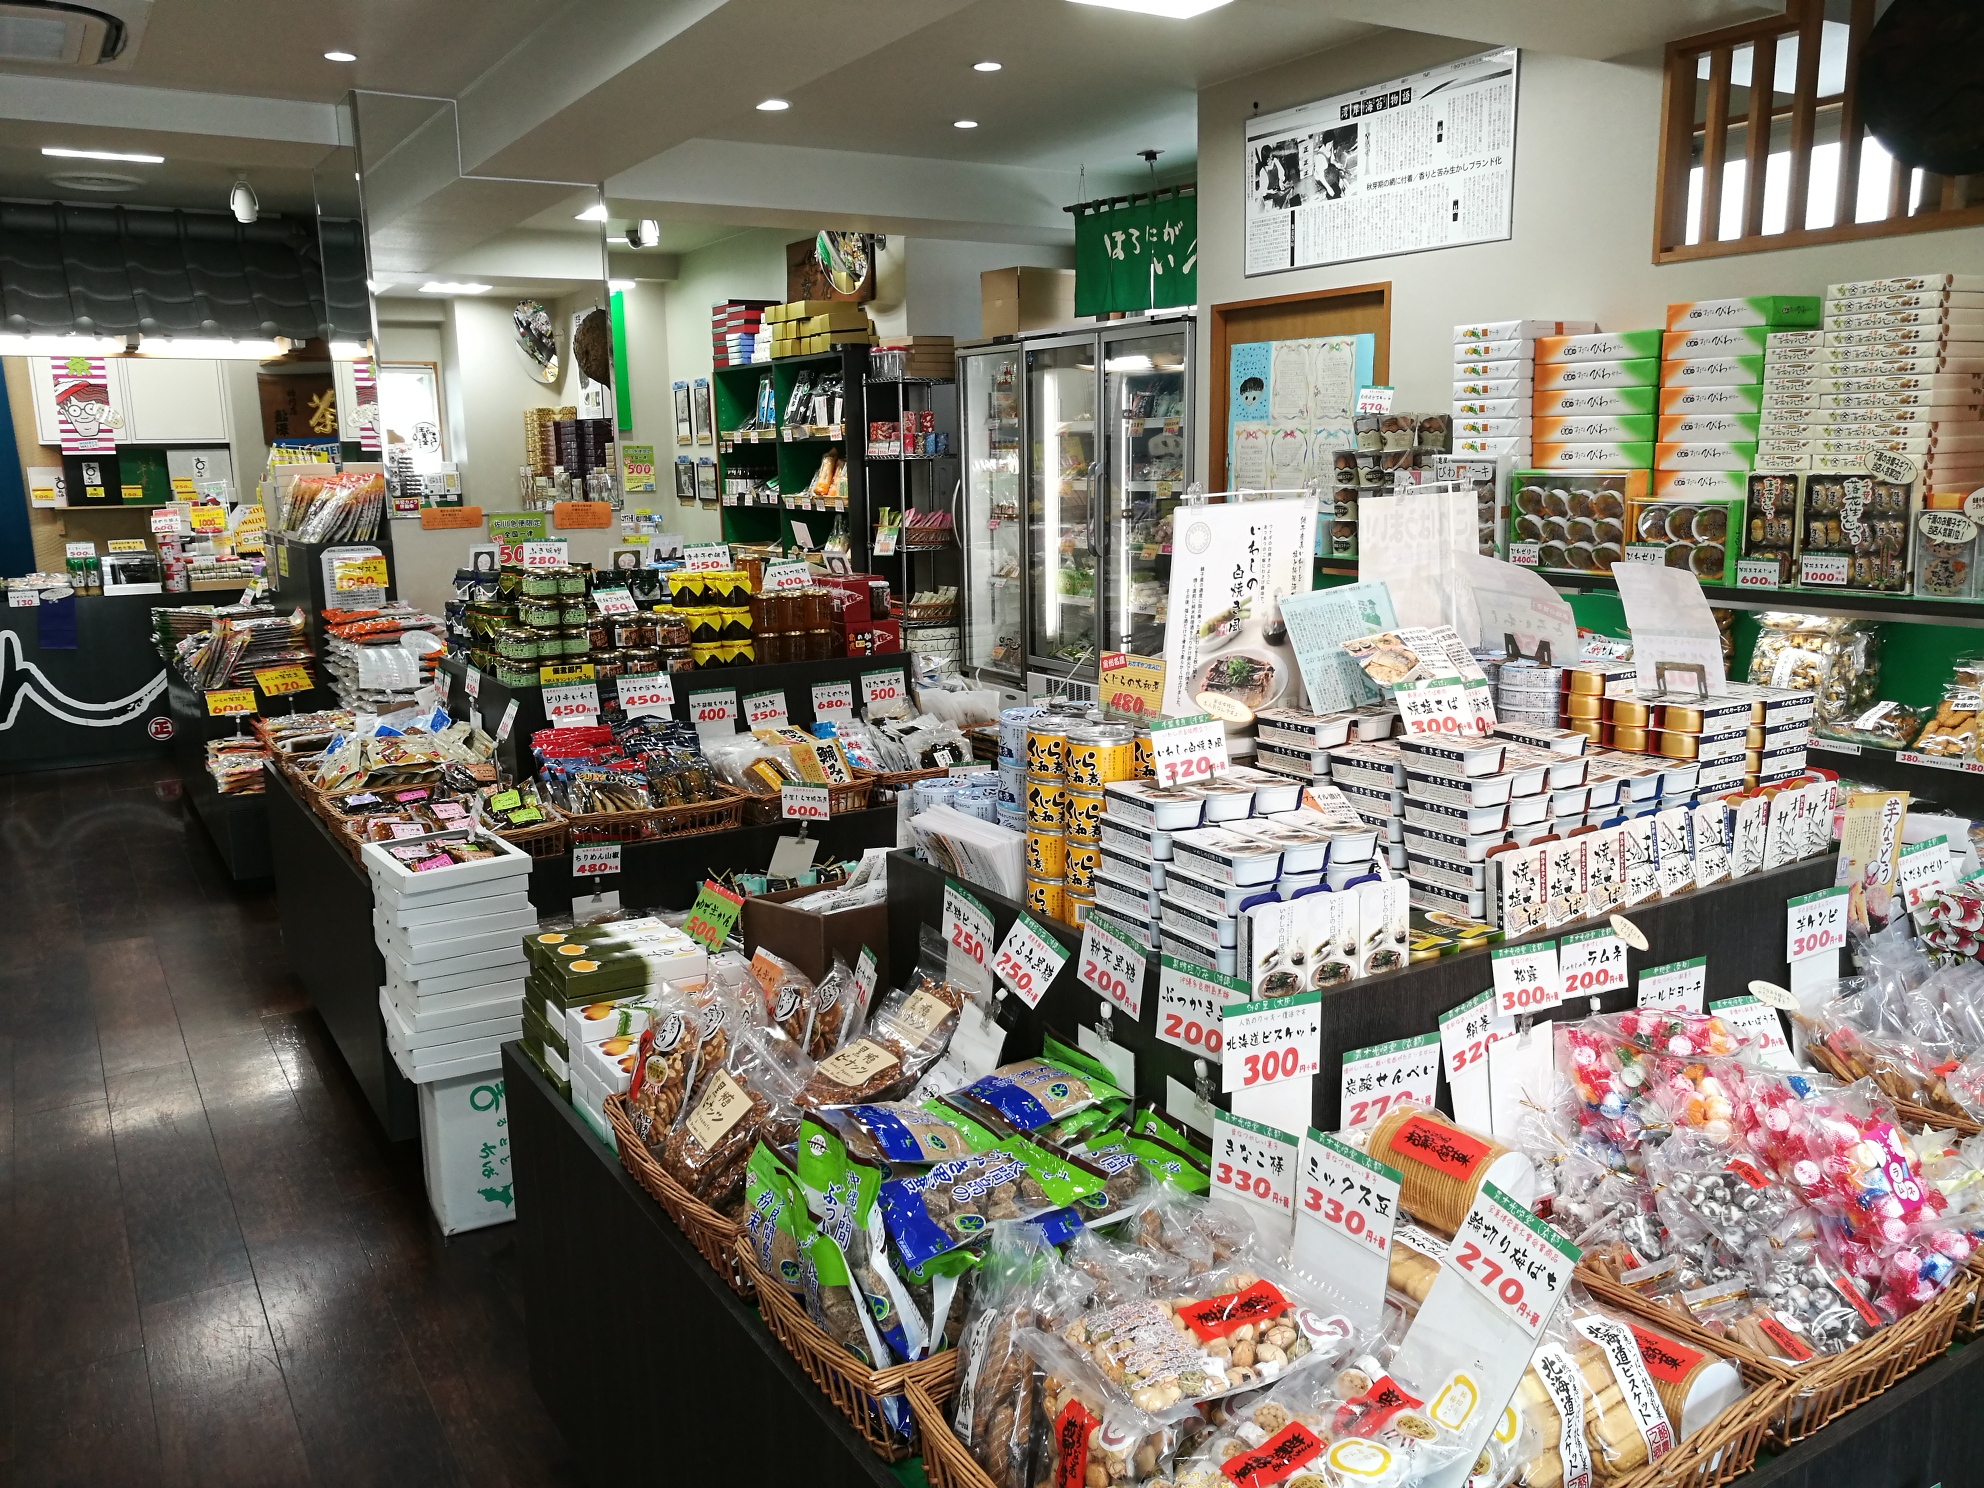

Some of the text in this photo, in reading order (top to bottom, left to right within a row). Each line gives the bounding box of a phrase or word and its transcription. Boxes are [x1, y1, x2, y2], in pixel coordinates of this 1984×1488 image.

[627, 464, 651, 475] 500
[1841, 479, 1863, 545] 落花生まんじゅう
[243, 535, 263, 543] O-CH
[500, 545, 523, 564] 50
[1246, 526, 1261, 591] いわしの
[1626, 551, 1663, 561] びわゼリー
[1228, 564, 1245, 634] 白焼き風
[1407, 697, 1458, 715] 焼塩さば
[154, 720, 172, 737] 正
[1157, 738, 1224, 758] いわしの白焼き風
[575, 851, 619, 862] ちりめん山椒
[1881, 799, 1900, 882] 芋なっとう
[1902, 860, 1949, 883] くだものゼリー
[1796, 908, 1838, 933] 芋ケンピ
[1007, 934, 1055, 982] くるみ黒糖
[1090, 936, 1136, 984] 粉末黒糖
[1514, 965, 1538, 984] 松露
[1588, 944, 1622, 966] ラムネ
[1164, 1013, 1223, 1053] 200
[1226, 1022, 1317, 1051] 北海道ビスケット
[1243, 1047, 1317, 1086] 300円+税
[1345, 1065, 1434, 1099] 炭酸せんべい
[1225, 1112, 1259, 1133] 青木光悦堂
[1226, 1138, 1285, 1177] きなこ棒
[1318, 1133, 1357, 1159] 青木光悦堂
[1216, 1162, 1290, 1209] 330円+税
[1307, 1156, 1391, 1218] ミックス豆
[762, 1196, 786, 1273] 良間島の
[1304, 1186, 1386, 1251] 330円+税
[1467, 1210, 1557, 1292] 輪切り梅ばち
[1455, 1241, 1541, 1328] 270円+税
[1587, 1325, 1651, 1426] 北海道ビスケット
[1541, 1356, 1579, 1476] 北海道ビスケット
